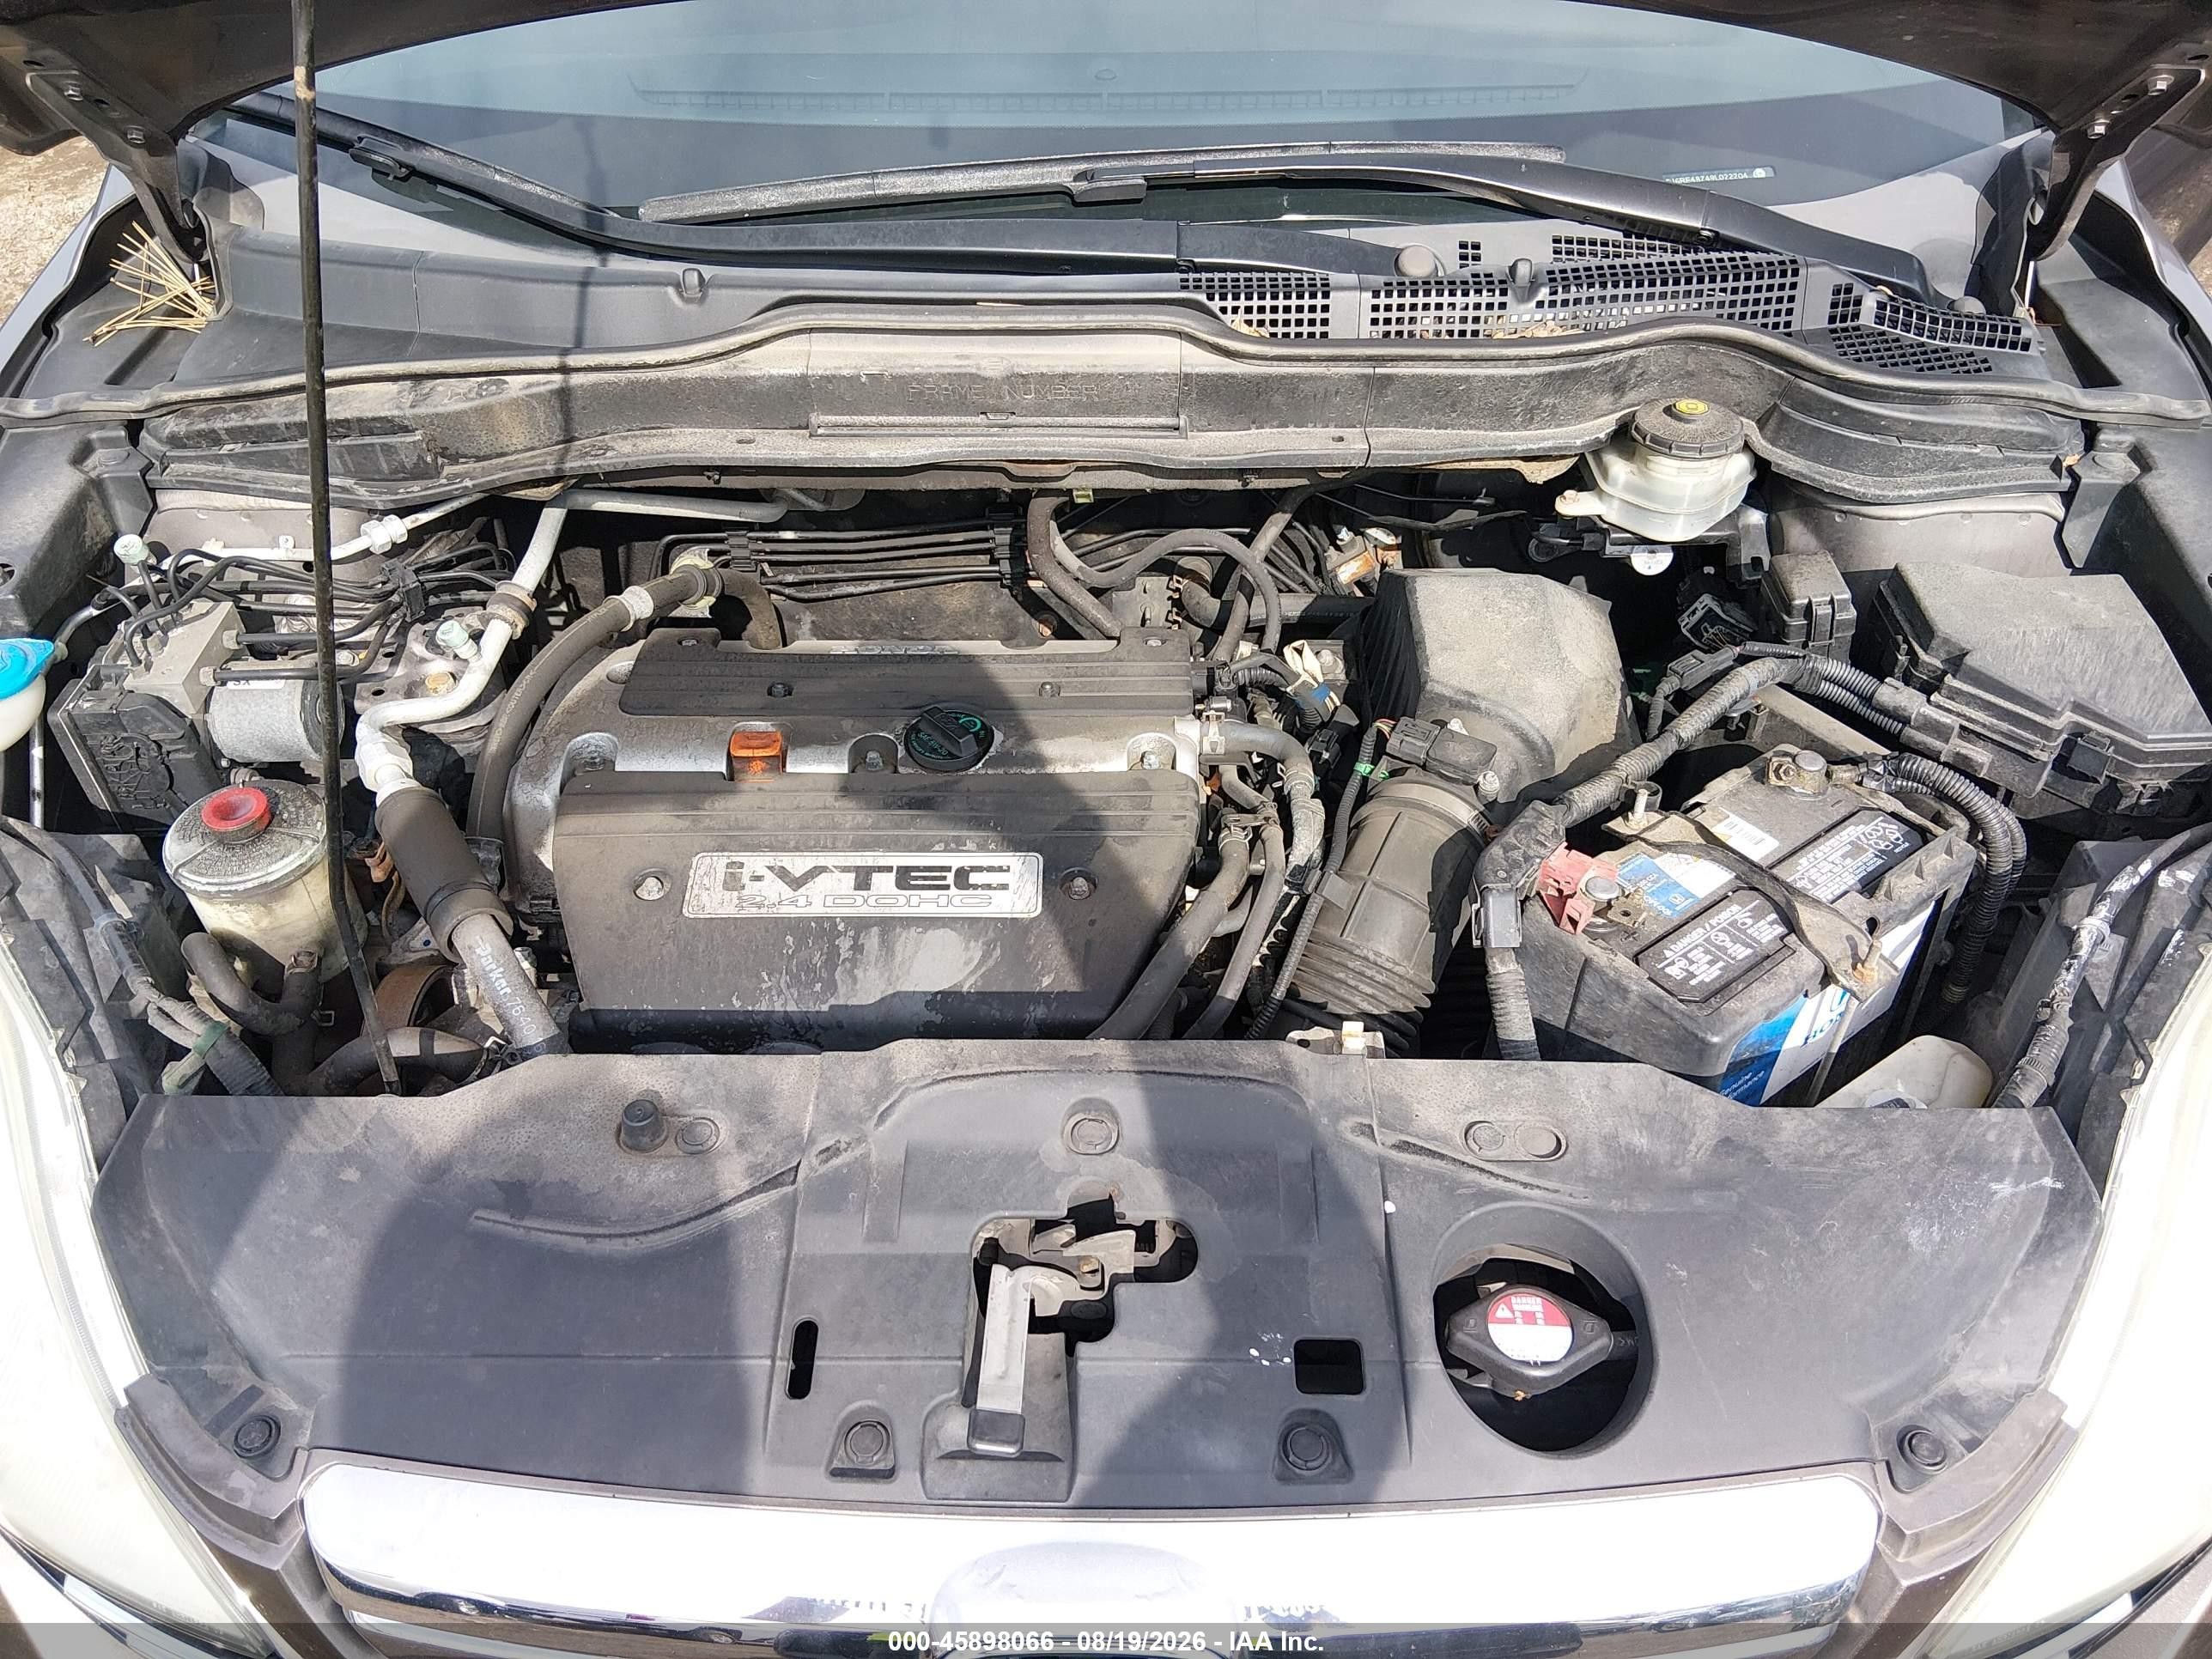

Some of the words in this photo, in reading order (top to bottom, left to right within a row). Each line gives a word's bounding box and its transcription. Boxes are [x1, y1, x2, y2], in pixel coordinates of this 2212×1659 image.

[908, 385, 985, 402] FRAME
[1004, 385, 1101, 402] NUMBER
[722, 861, 1012, 892] i-VTEC
[736, 894, 812, 909] 2.4
[823, 894, 993, 908] DOHC
[1669, 927, 1707, 951] DANGER
[1709, 904, 1743, 927] POISON
[474, 935, 512, 996] Parker
